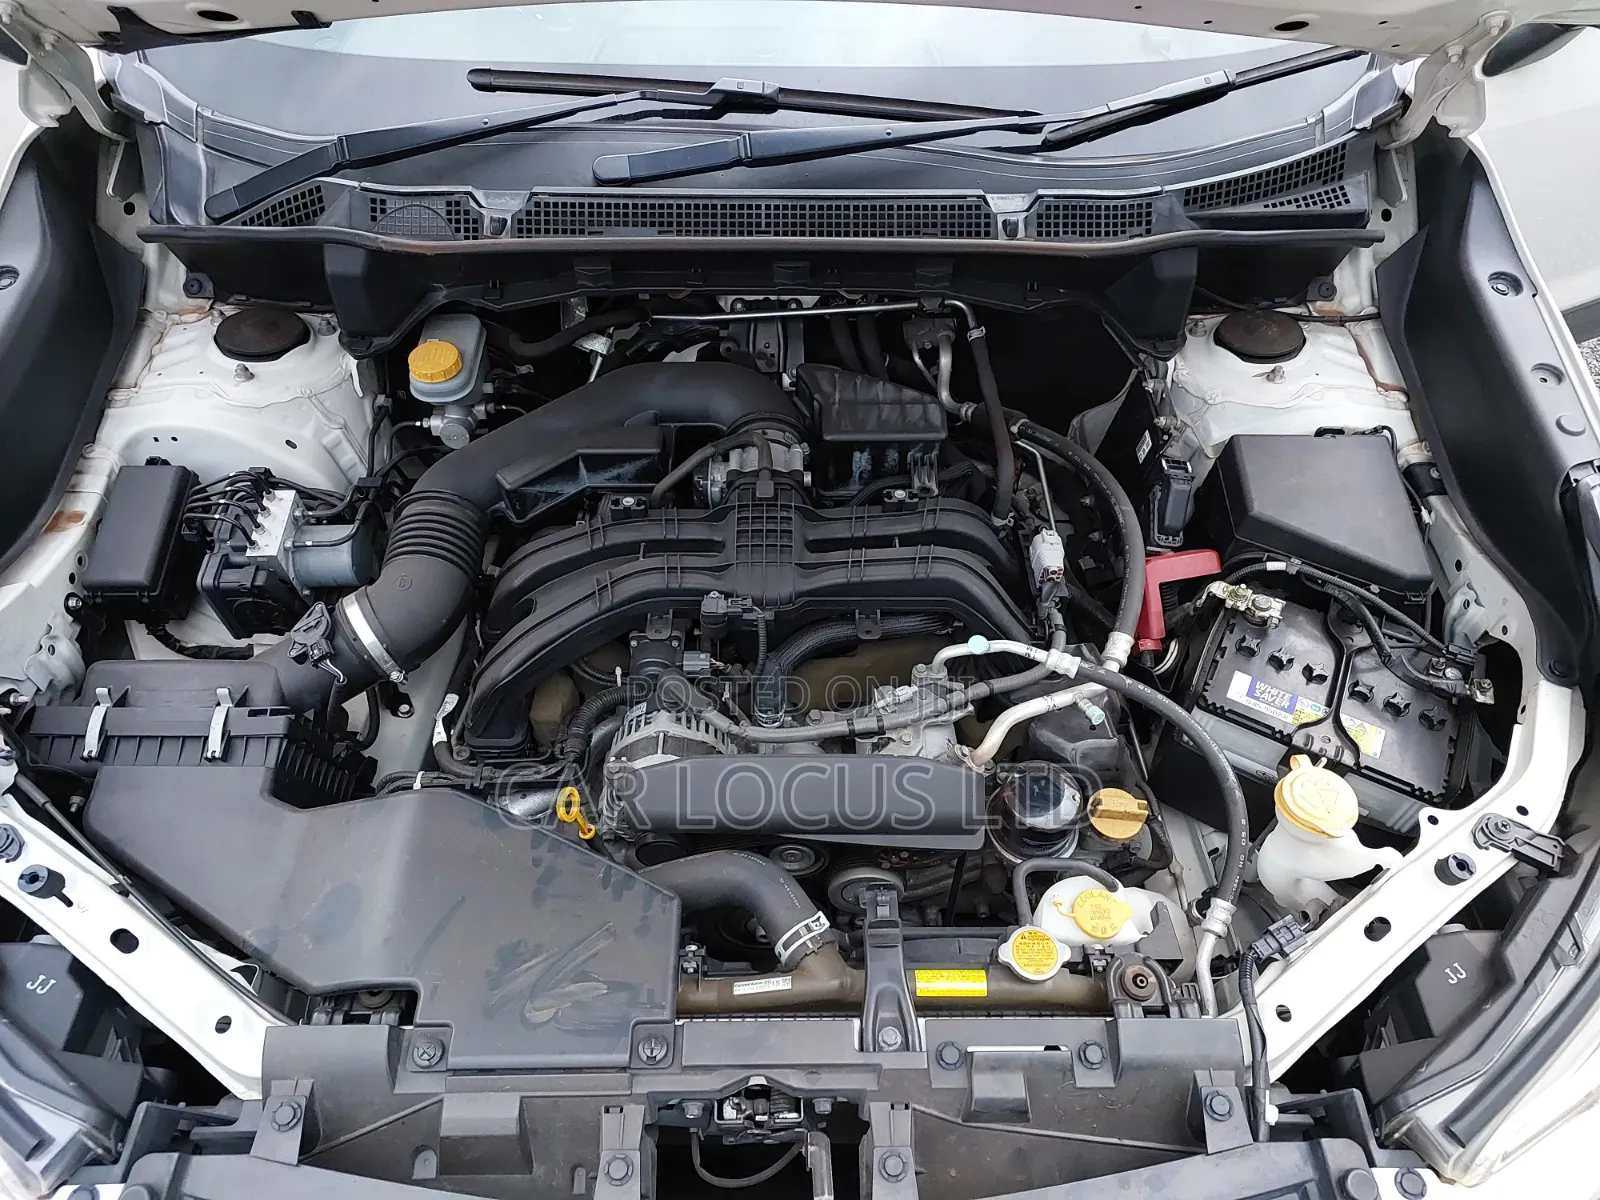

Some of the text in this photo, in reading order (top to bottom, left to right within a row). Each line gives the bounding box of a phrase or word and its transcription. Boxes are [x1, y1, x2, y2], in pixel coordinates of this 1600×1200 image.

[1253, 689, 1290, 709] SAVER
[1255, 681, 1294, 701] WHITE
[1077, 890, 1117, 908] COOLANT
[1444, 962, 1467, 984] JJ
[26, 974, 57, 994] JJ
